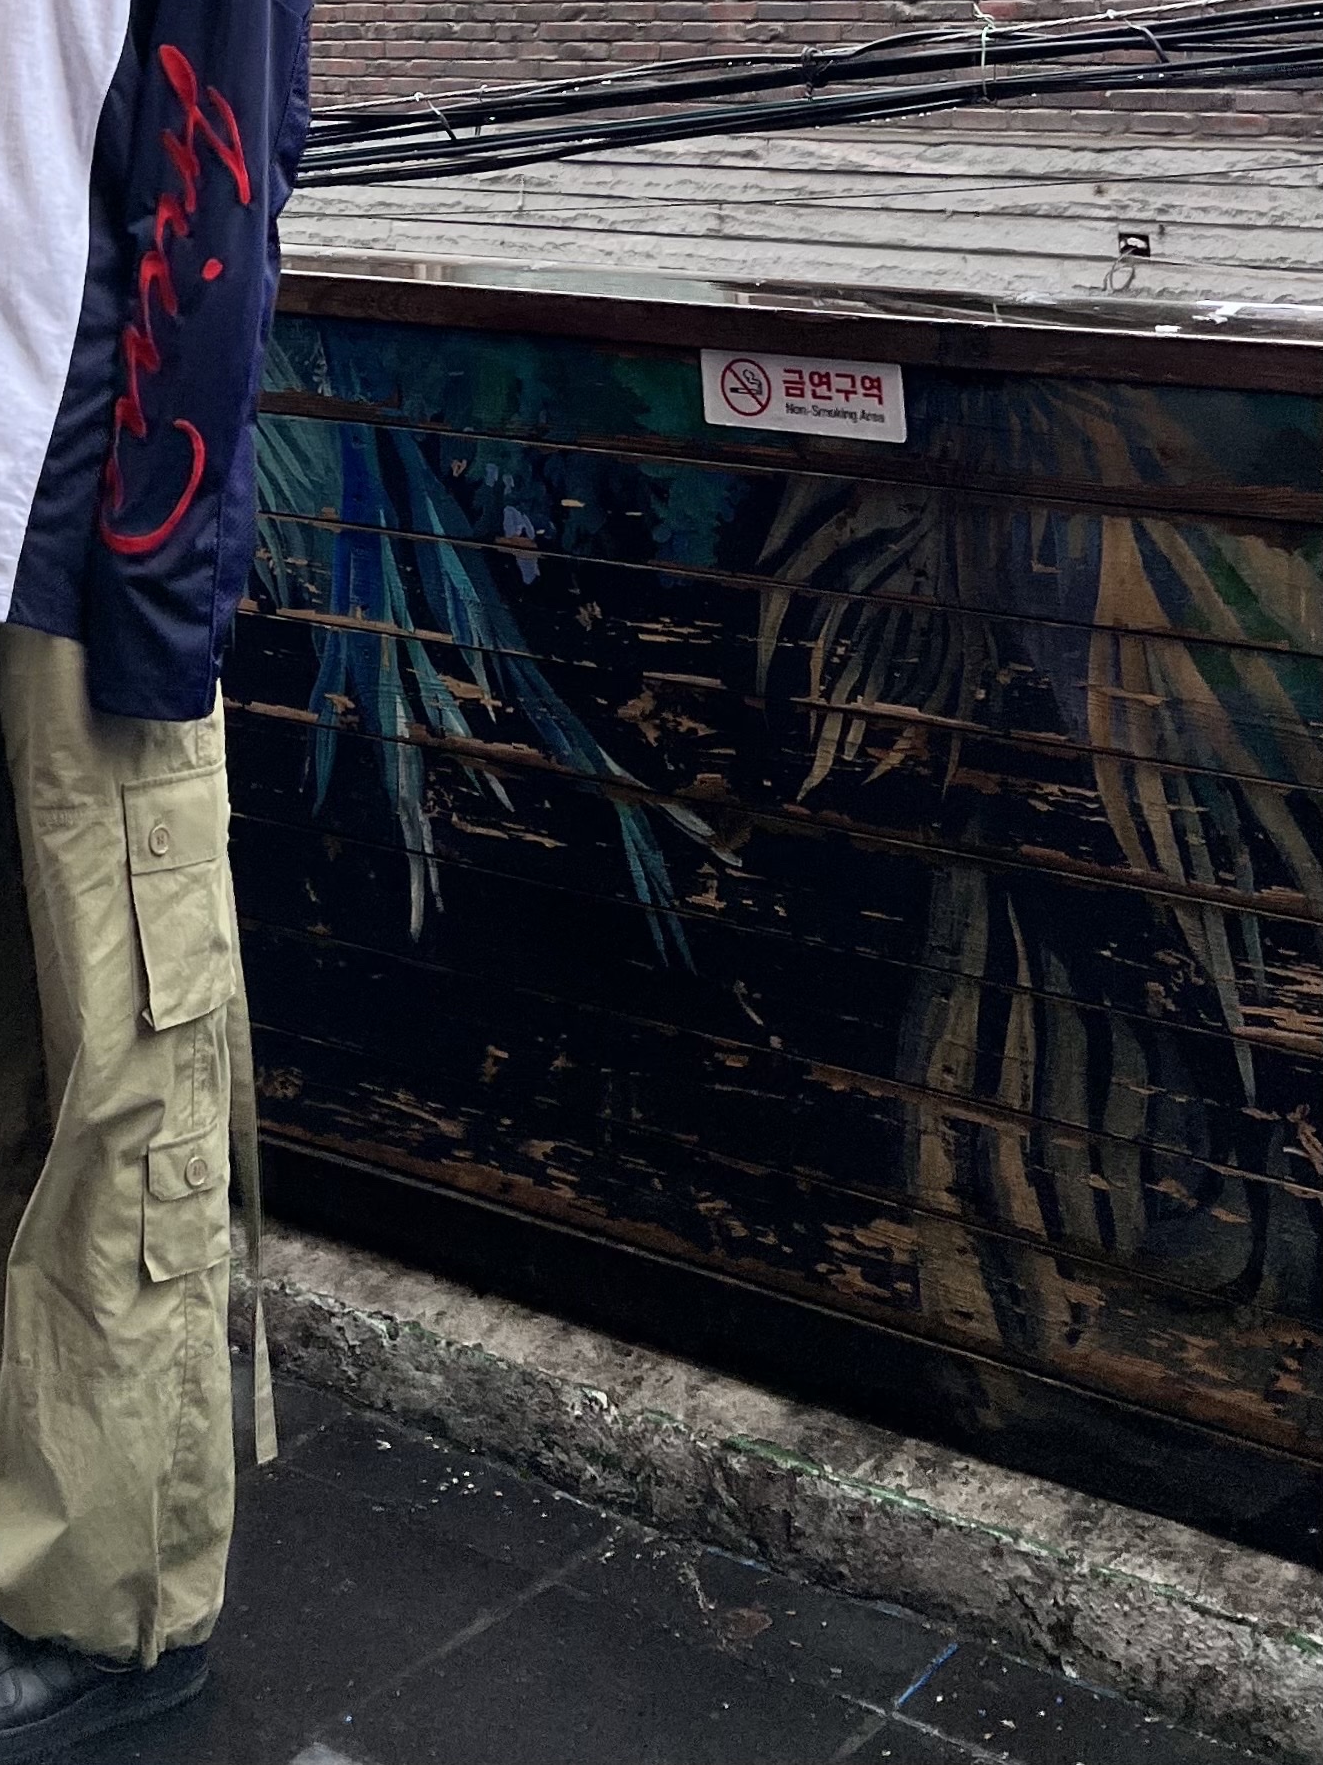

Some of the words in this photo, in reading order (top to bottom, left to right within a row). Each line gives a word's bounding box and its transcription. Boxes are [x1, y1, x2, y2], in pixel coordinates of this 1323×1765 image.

[782, 368, 884, 406] 금연구역
[785, 402, 858, 423] Non-Smoking
[860, 409, 885, 423] Area
